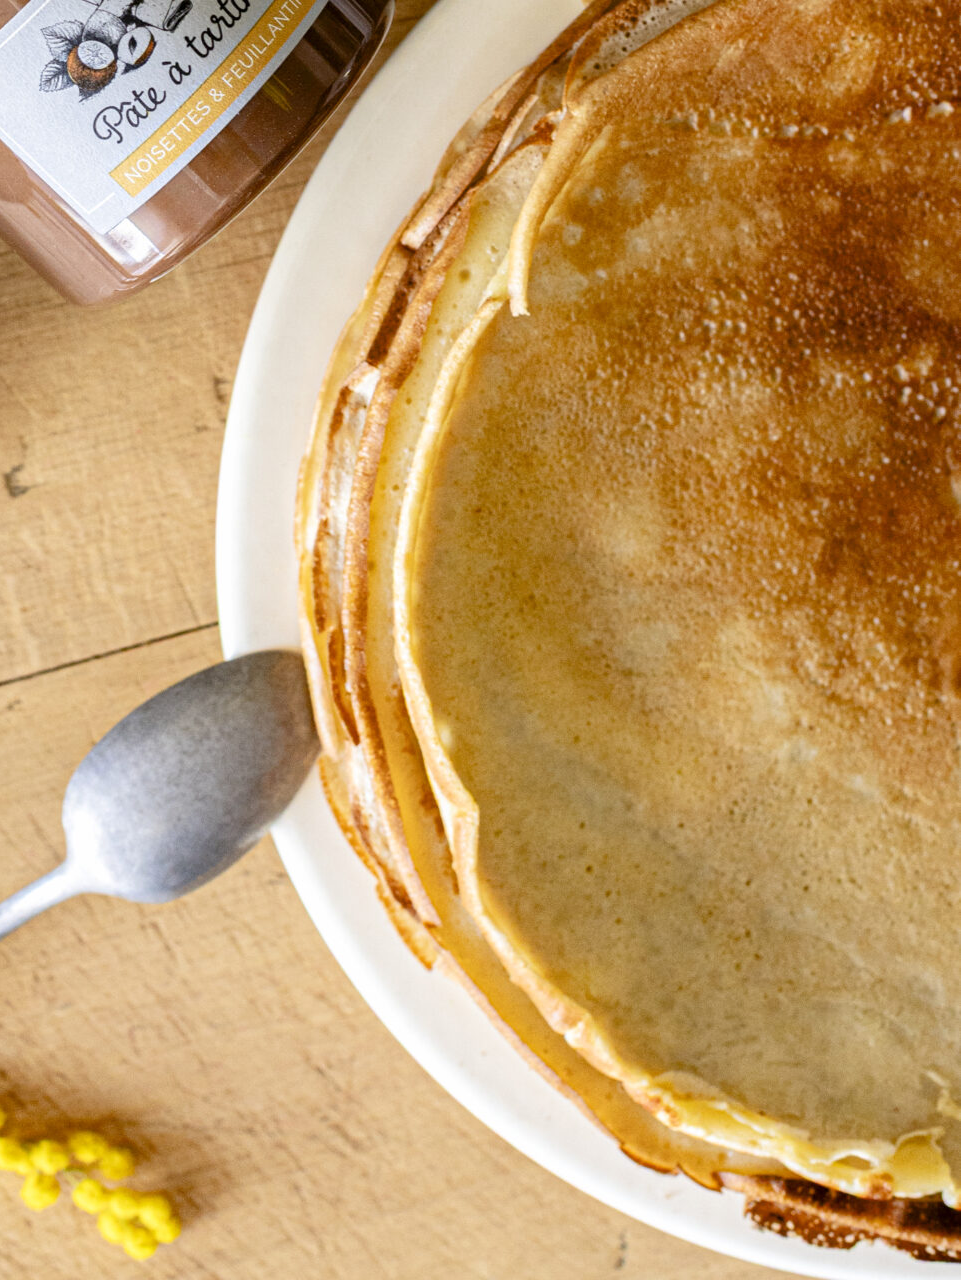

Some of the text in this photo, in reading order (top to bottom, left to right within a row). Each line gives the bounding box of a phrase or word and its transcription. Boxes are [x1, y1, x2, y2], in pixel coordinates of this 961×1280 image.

[92, 86, 166, 144] Pâte
[162, 60, 192, 86] à
[123, 99, 212, 184] NOISETTES
[208, 87, 226, 103] &
